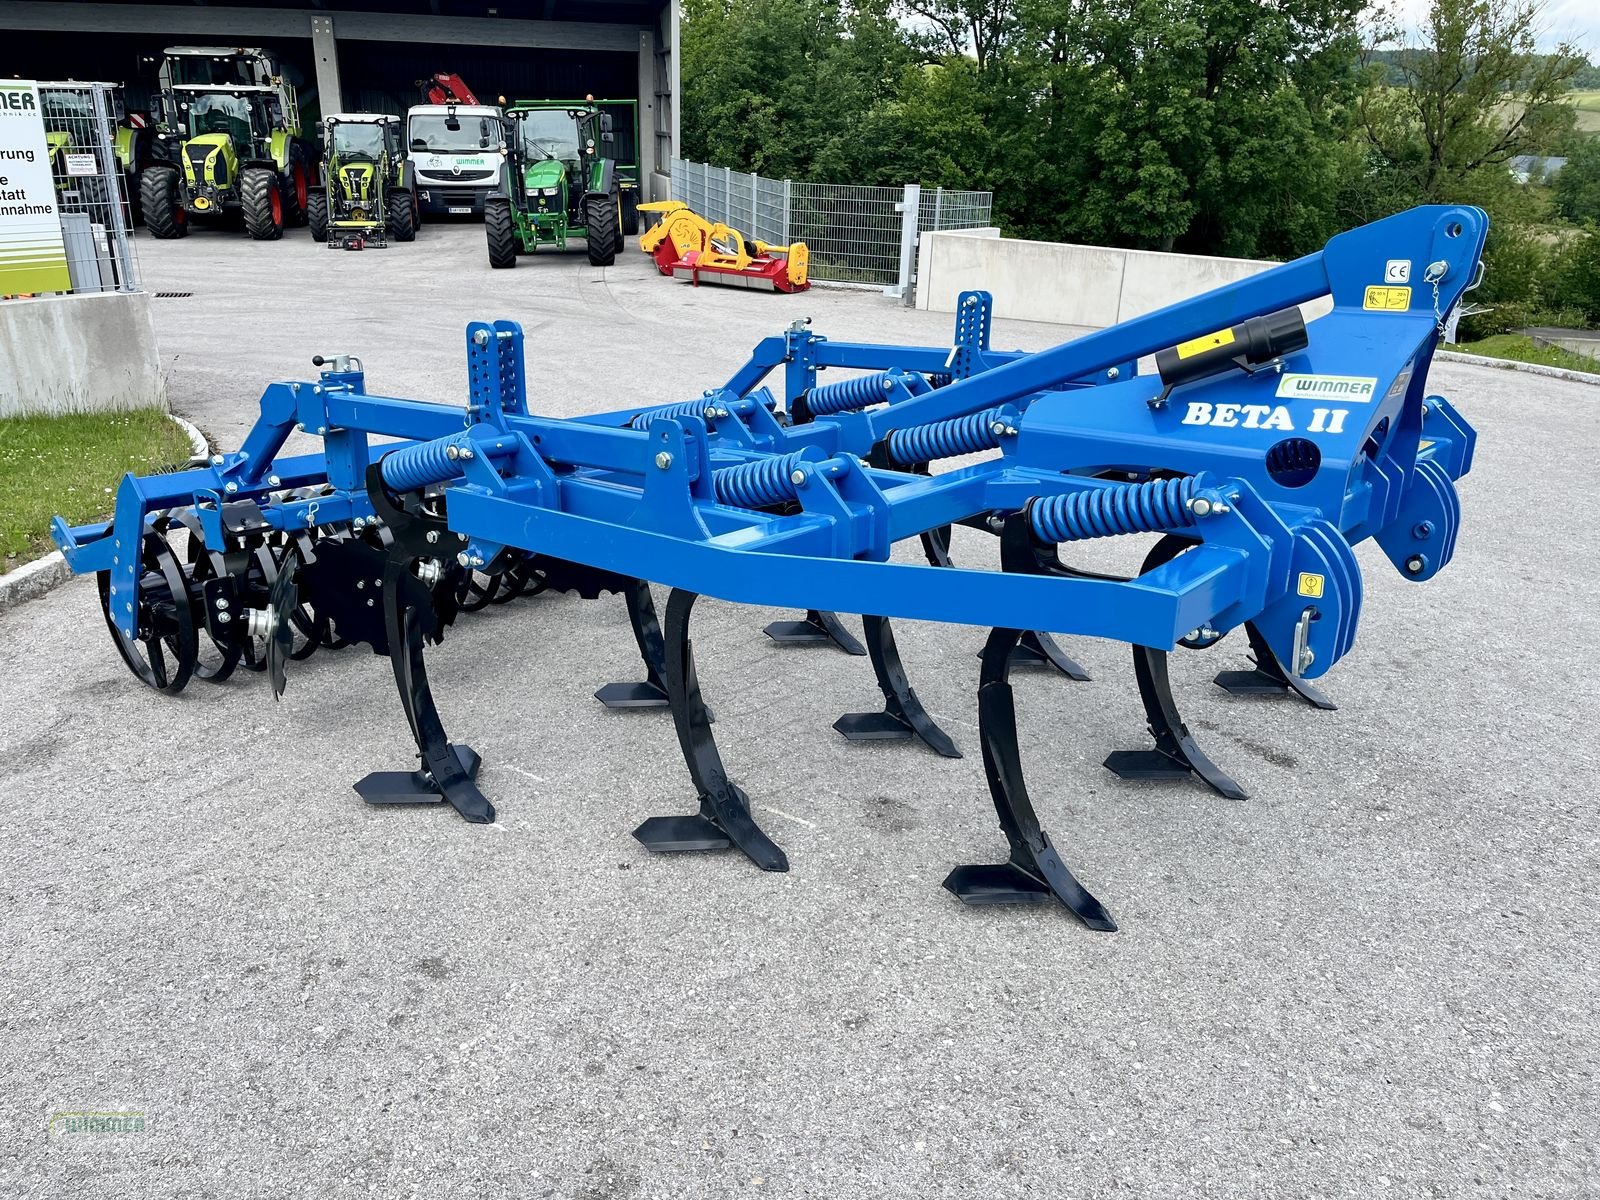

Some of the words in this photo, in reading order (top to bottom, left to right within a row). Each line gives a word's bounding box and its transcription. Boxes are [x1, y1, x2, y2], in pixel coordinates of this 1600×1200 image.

[0, 203, 52, 215] nnahme
[1296, 379, 1372, 395] WIMMER
[1181, 402, 1295, 431] BETA
[1306, 408, 1349, 433] II
